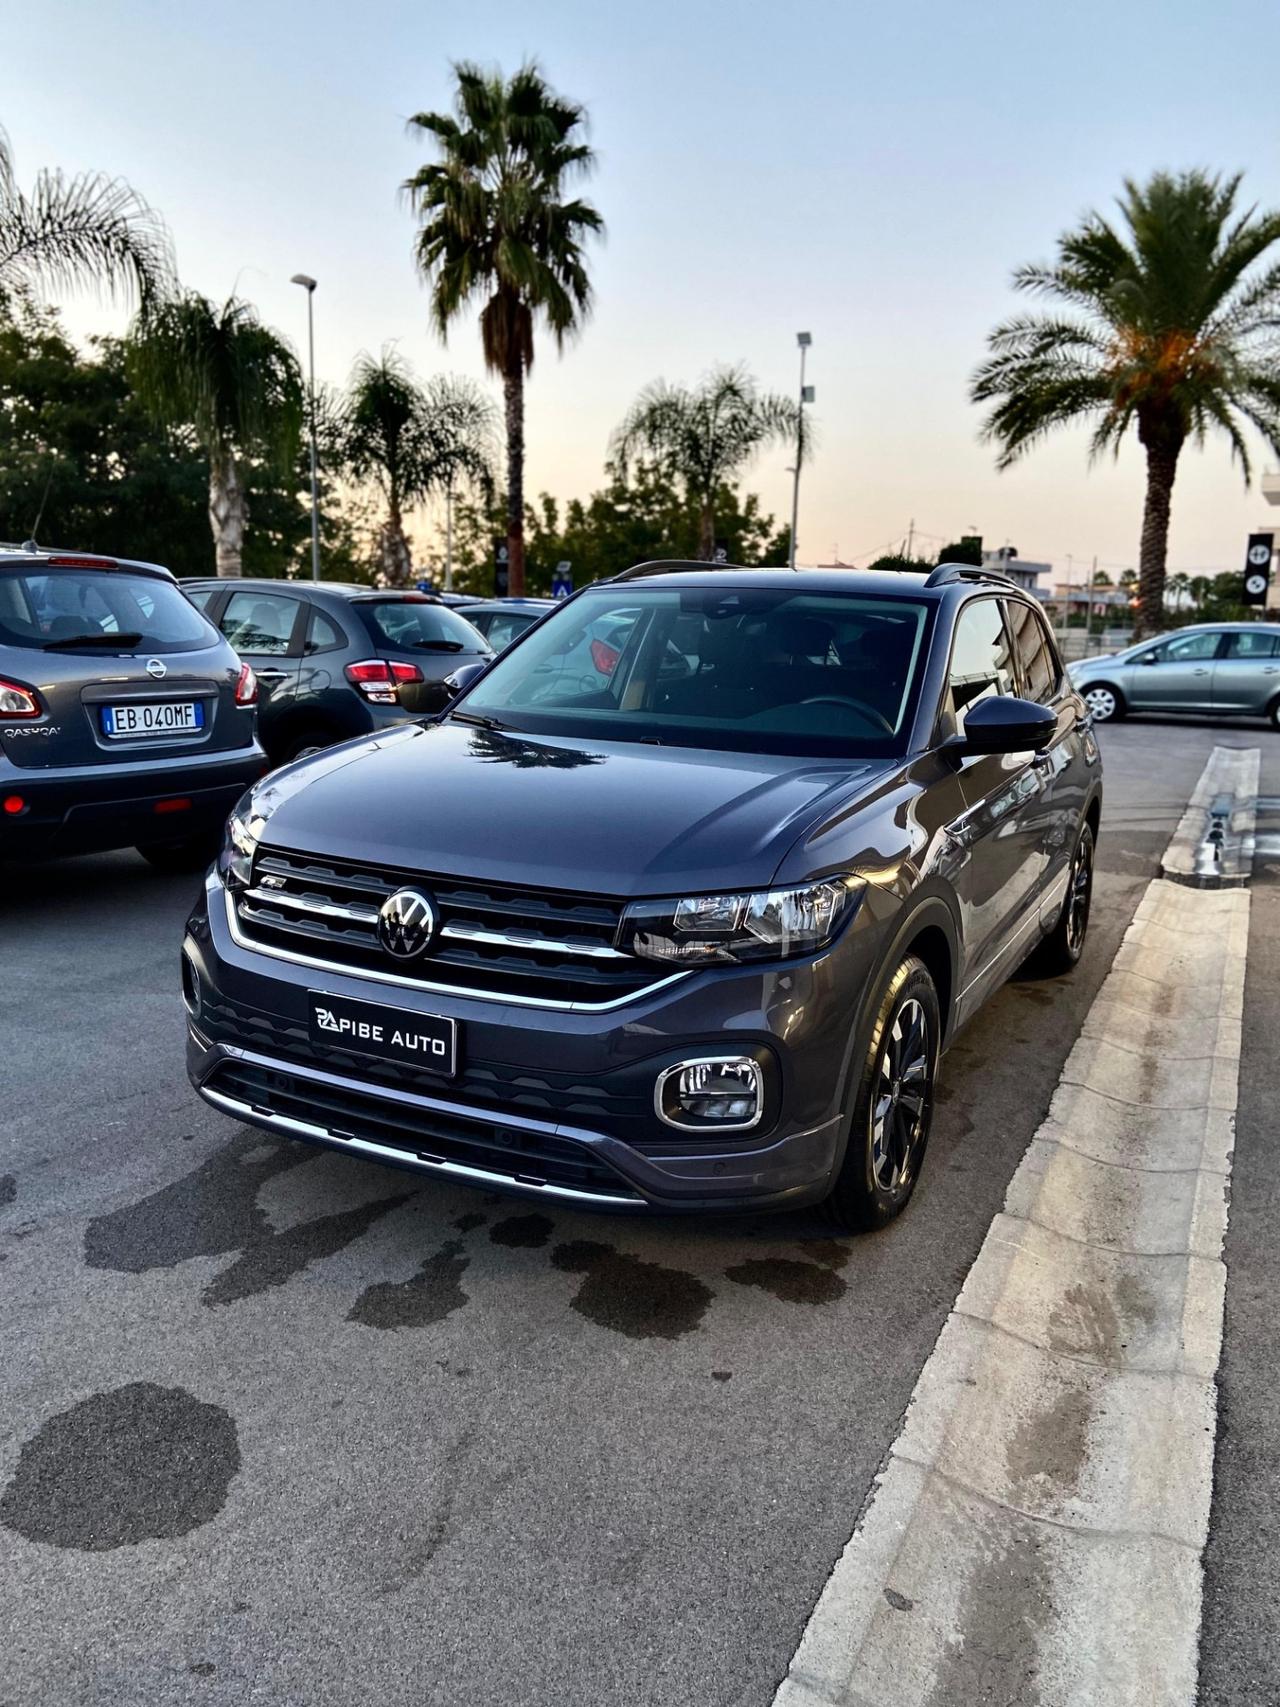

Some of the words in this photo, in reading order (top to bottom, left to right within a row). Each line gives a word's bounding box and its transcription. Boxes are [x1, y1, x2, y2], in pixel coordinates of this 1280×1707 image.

[115, 708, 137, 730] EB
[143, 705, 193, 728] 040MF
[4, 727, 61, 739] QASHQA
[390, 1030, 446, 1056] AUTO
